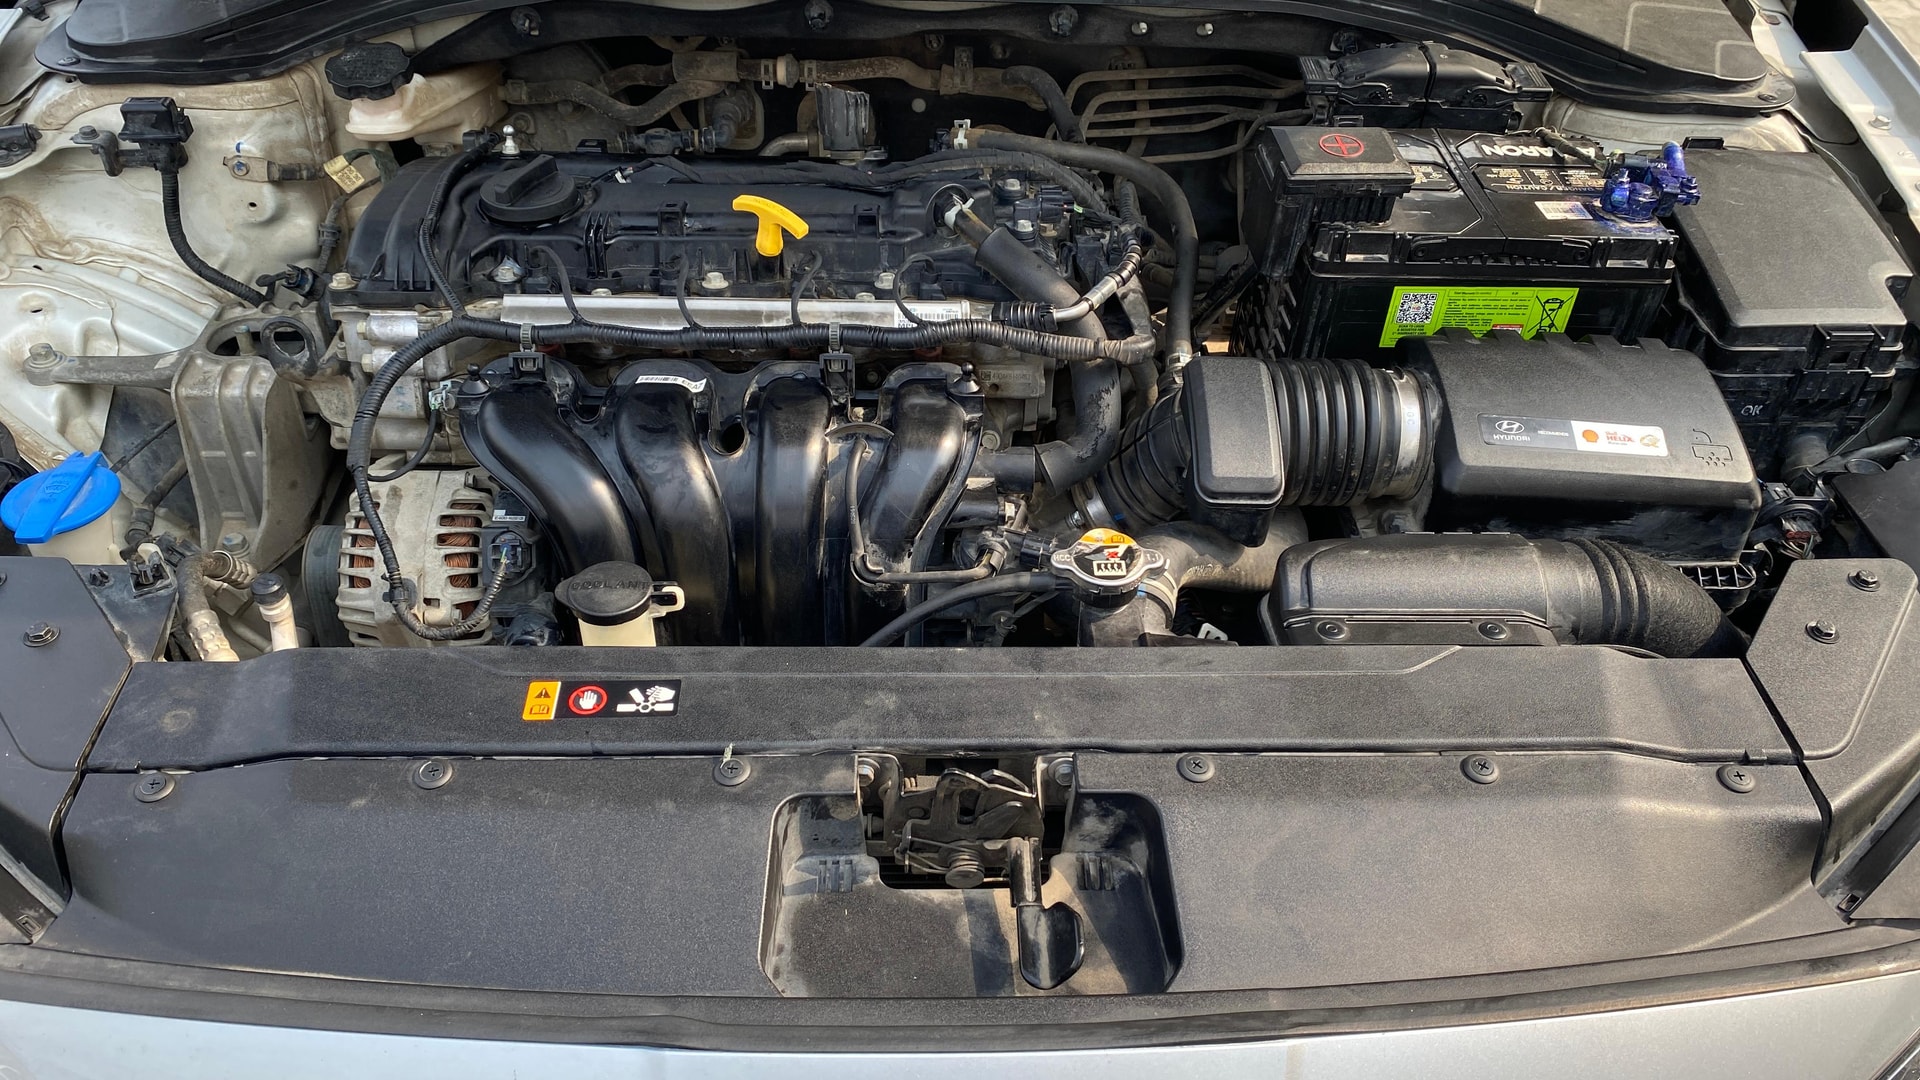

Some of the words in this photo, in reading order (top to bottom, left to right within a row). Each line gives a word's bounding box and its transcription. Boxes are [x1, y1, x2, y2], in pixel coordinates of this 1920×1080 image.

[1481, 144, 1596, 157] AARON
[1740, 405, 1763, 416] OK
[1493, 434, 1531, 442] HYUNDAI
[1606, 434, 1634, 442] HELIX
[572, 580, 650, 590] COOLANT
